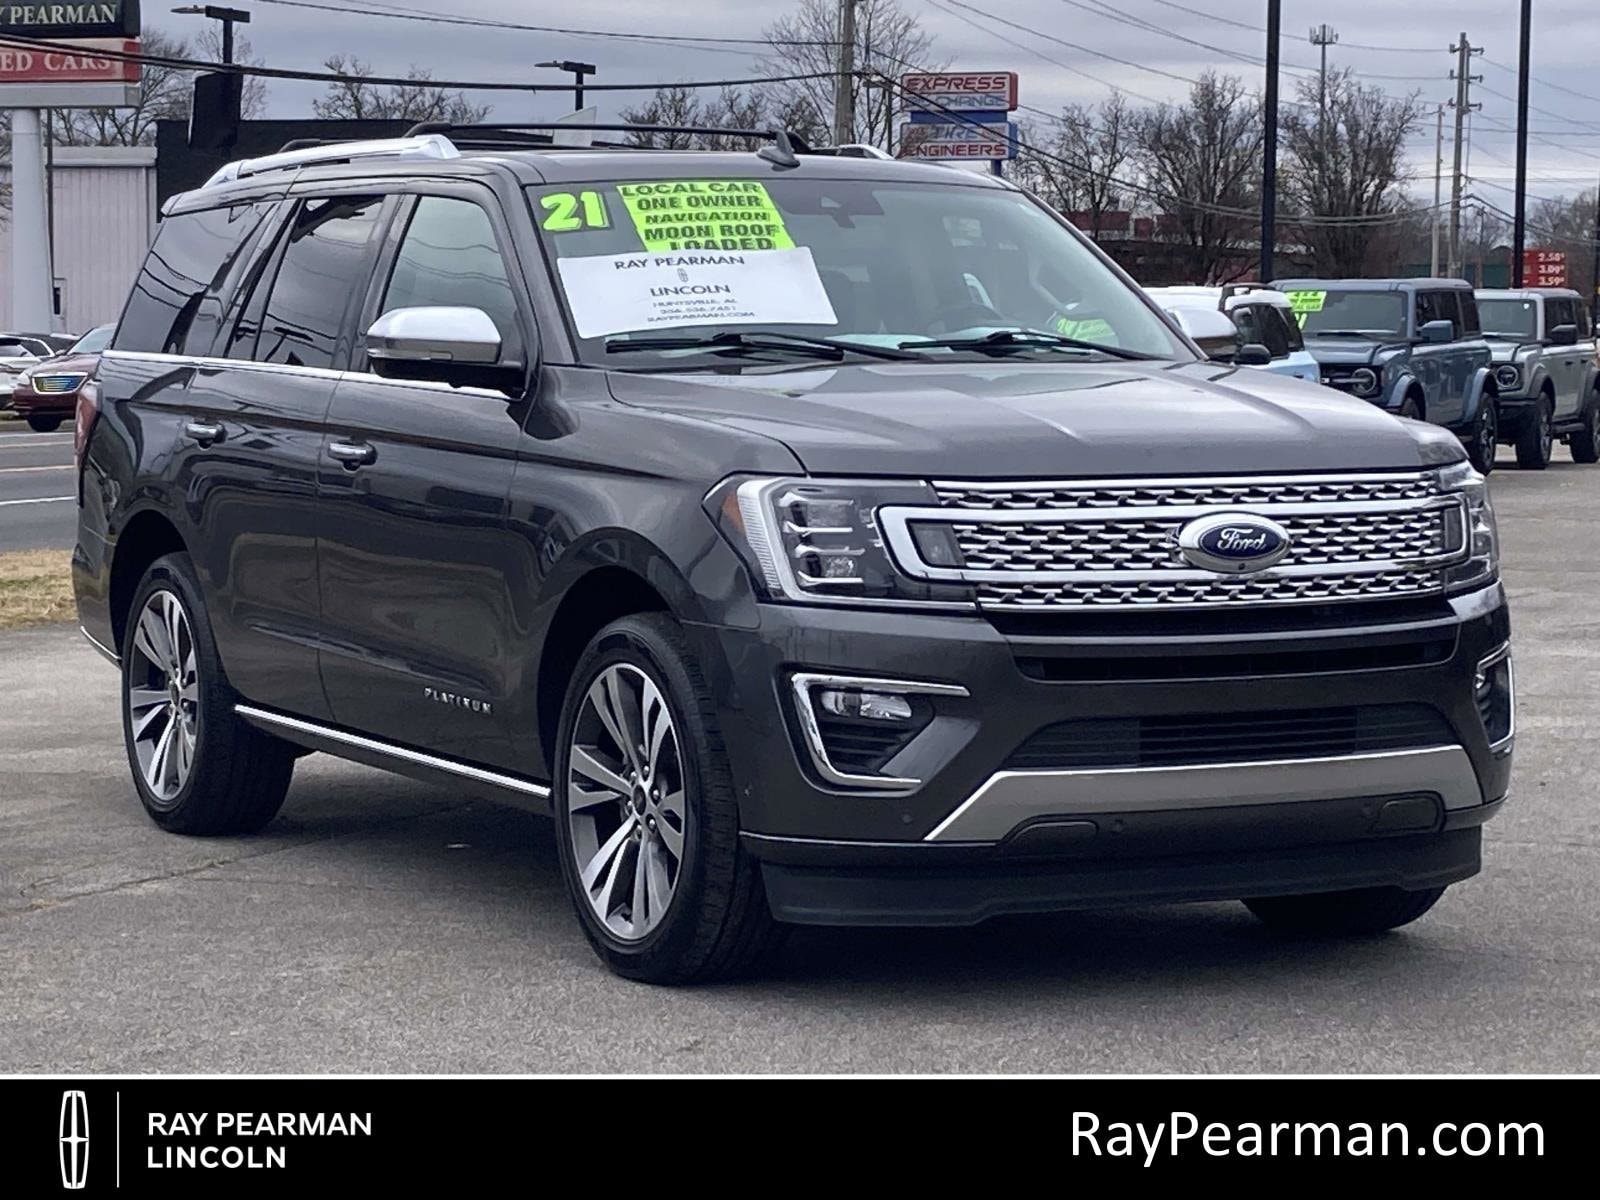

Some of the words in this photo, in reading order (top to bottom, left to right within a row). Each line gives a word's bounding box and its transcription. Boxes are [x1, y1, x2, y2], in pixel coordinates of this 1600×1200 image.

[9, 4, 118, 25] PEARMAN
[44, 52, 111, 71] CARS
[905, 76, 1007, 91] EXPRESS
[905, 143, 1007, 157] ENGINEERS
[621, 183, 704, 197] LOCAL
[708, 182, 760, 193] CAR
[636, 196, 682, 211] ONE
[686, 194, 763, 208] OWNER
[540, 191, 610, 231] 21
[645, 211, 769, 224] NAVIGATION
[644, 226, 714, 241] MOON
[718, 224, 779, 238] ROOF
[669, 237, 776, 251] LOADED
[614, 259, 648, 269] RAY
[655, 255, 746, 267] PEARMAN
[650, 284, 731, 296] LINCOLN
[1216, 527, 1267, 551] Ford
[424, 687, 492, 715] PLATINUM
